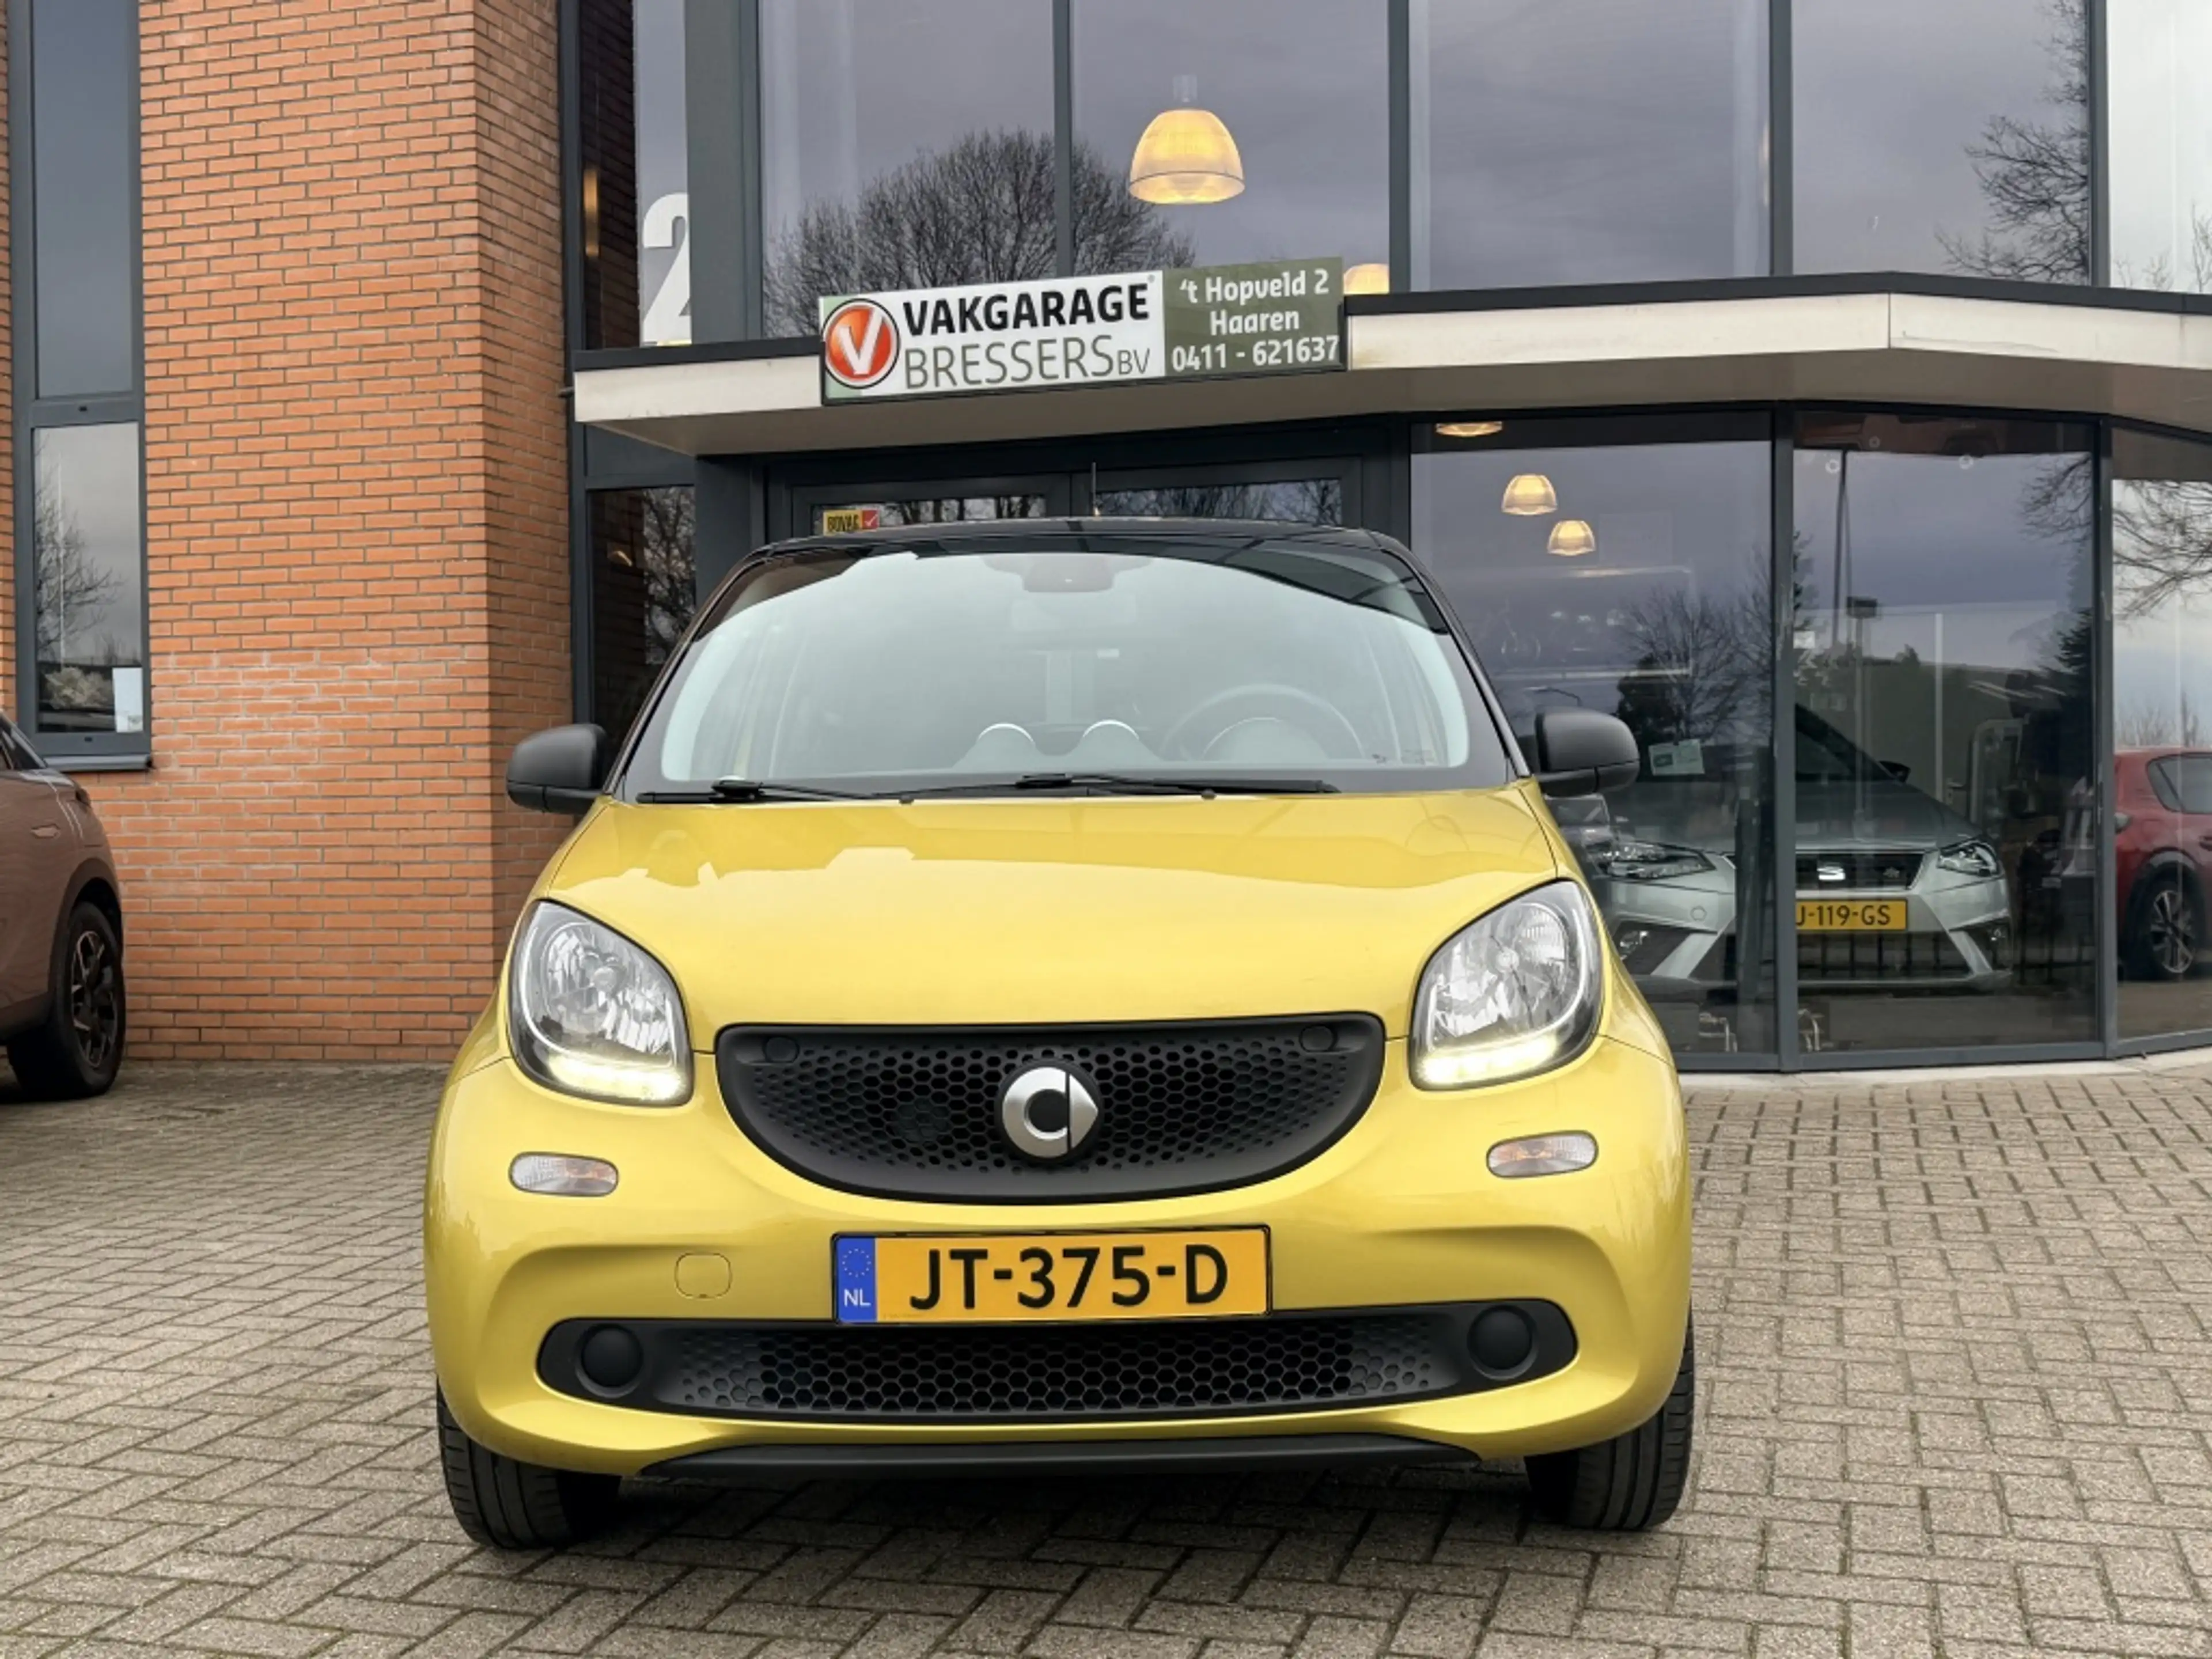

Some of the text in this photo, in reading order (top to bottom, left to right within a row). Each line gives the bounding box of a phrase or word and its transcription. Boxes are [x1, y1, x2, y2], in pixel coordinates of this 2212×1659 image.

[1205, 270, 1306, 306] Hopveld
[1314, 268, 1329, 295] 2
[903, 283, 1150, 336] VAKGARAGE
[1210, 309, 1300, 336] Haaren
[905, 334, 1114, 389] BRESSERS
[1172, 343, 1227, 372] 0411
[1252, 335, 1340, 366] 621637
[910, 1244, 1228, 1309] JT-375-D
[844, 1288, 872, 1307] NL
